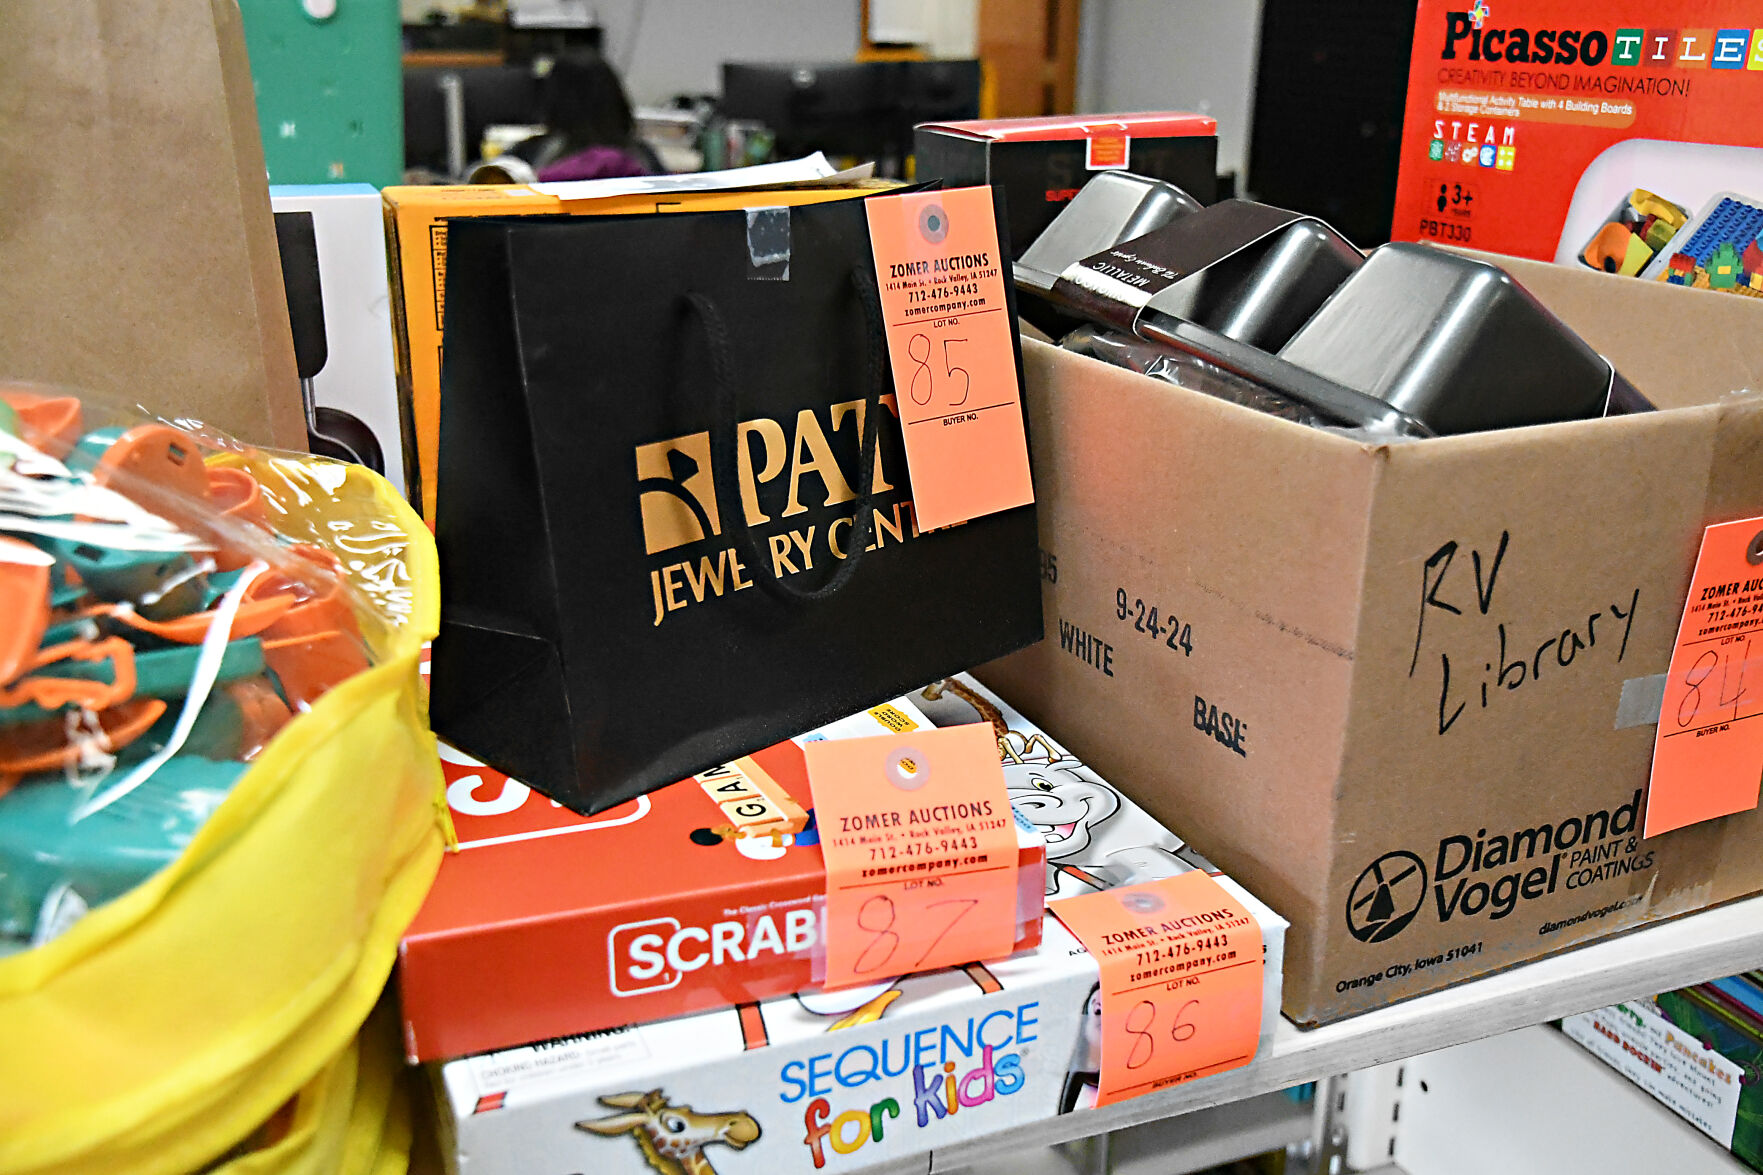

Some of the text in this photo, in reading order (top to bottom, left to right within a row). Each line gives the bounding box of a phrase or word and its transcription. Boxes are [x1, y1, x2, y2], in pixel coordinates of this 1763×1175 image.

[1441, 12, 1608, 66] Picasso
[1438, 68, 1691, 97] CREATIVITY BEYOND IMAGINATION!
[1480, 105, 1520, 117] Containers
[1488, 95, 1515, 107] Activity
[1518, 97, 1538, 109] Table
[1541, 99, 1556, 109] with
[1558, 100, 1564, 109] 4
[1566, 101, 1599, 116] Building
[1601, 102, 1632, 115] Boards
[1452, 184, 1473, 206] 3+
[886, 282, 900, 291] 1414
[902, 281, 917, 289] Main
[949, 274, 969, 283] Valley,
[979, 269, 998, 278] 51247
[890, 253, 989, 278] ZOMER AUCTIONS
[1092, 262, 1151, 287] METALLIC
[905, 298, 986, 316] zomercompany.com
[909, 283, 978, 303] 712-476-9443
[934, 318, 960, 328] LOT NO.
[908, 333, 970, 406] 85
[943, 414, 978, 426] BUYER NO.
[650, 525, 816, 627] JEWERY
[1700, 583, 1740, 601] ZOMER
[1409, 530, 1509, 678] RV
[1116, 587, 1193, 657] 9-24-24
[1059, 618, 1114, 678] WHITE
[1721, 637, 1734, 645] LOT
[1439, 588, 1639, 735] Library
[1678, 640, 1751, 728] 84
[882, 711, 903, 727] WORD
[886, 708, 910, 726] SCORE
[1193, 694, 1248, 758] BASE
[1696, 727, 1712, 738] BUYER
[840, 812, 902, 832] ZOMER
[909, 800, 993, 825] AUCTIONS
[833, 838, 856, 847] 1414
[860, 834, 882, 844] Main
[910, 829, 928, 838] Rock
[966, 823, 975, 832] IA
[979, 819, 1006, 830] 51247
[869, 836, 978, 861] 712-476-9443
[1435, 788, 1643, 882] Diamond
[862, 854, 988, 878] zomercompany.com
[1570, 836, 1639, 869] PAINT &
[904, 879, 924, 890] LOT
[1566, 851, 1655, 889] COATINGS
[1434, 854, 1560, 922] Vogel
[853, 894, 979, 974] 87
[1101, 908, 1234, 945] ZOMER AUCTIONS
[1102, 948, 1122, 956] 1414
[1124, 942, 1146, 951] Main
[1166, 933, 1185, 942] Rock
[1215, 923, 1224, 931] IA
[1226, 917, 1250, 928] 51247
[1130, 950, 1237, 982] zomercompany.com
[1137, 934, 1228, 966] 712-476-9443
[1336, 942, 1482, 993] Orange City, Iowa 51041
[1166, 977, 1200, 991] LOT NO.
[1125, 1000, 1200, 1070] 86
[779, 1001, 1039, 1104] SEQUENCE
[804, 1044, 1026, 1169] for kids
